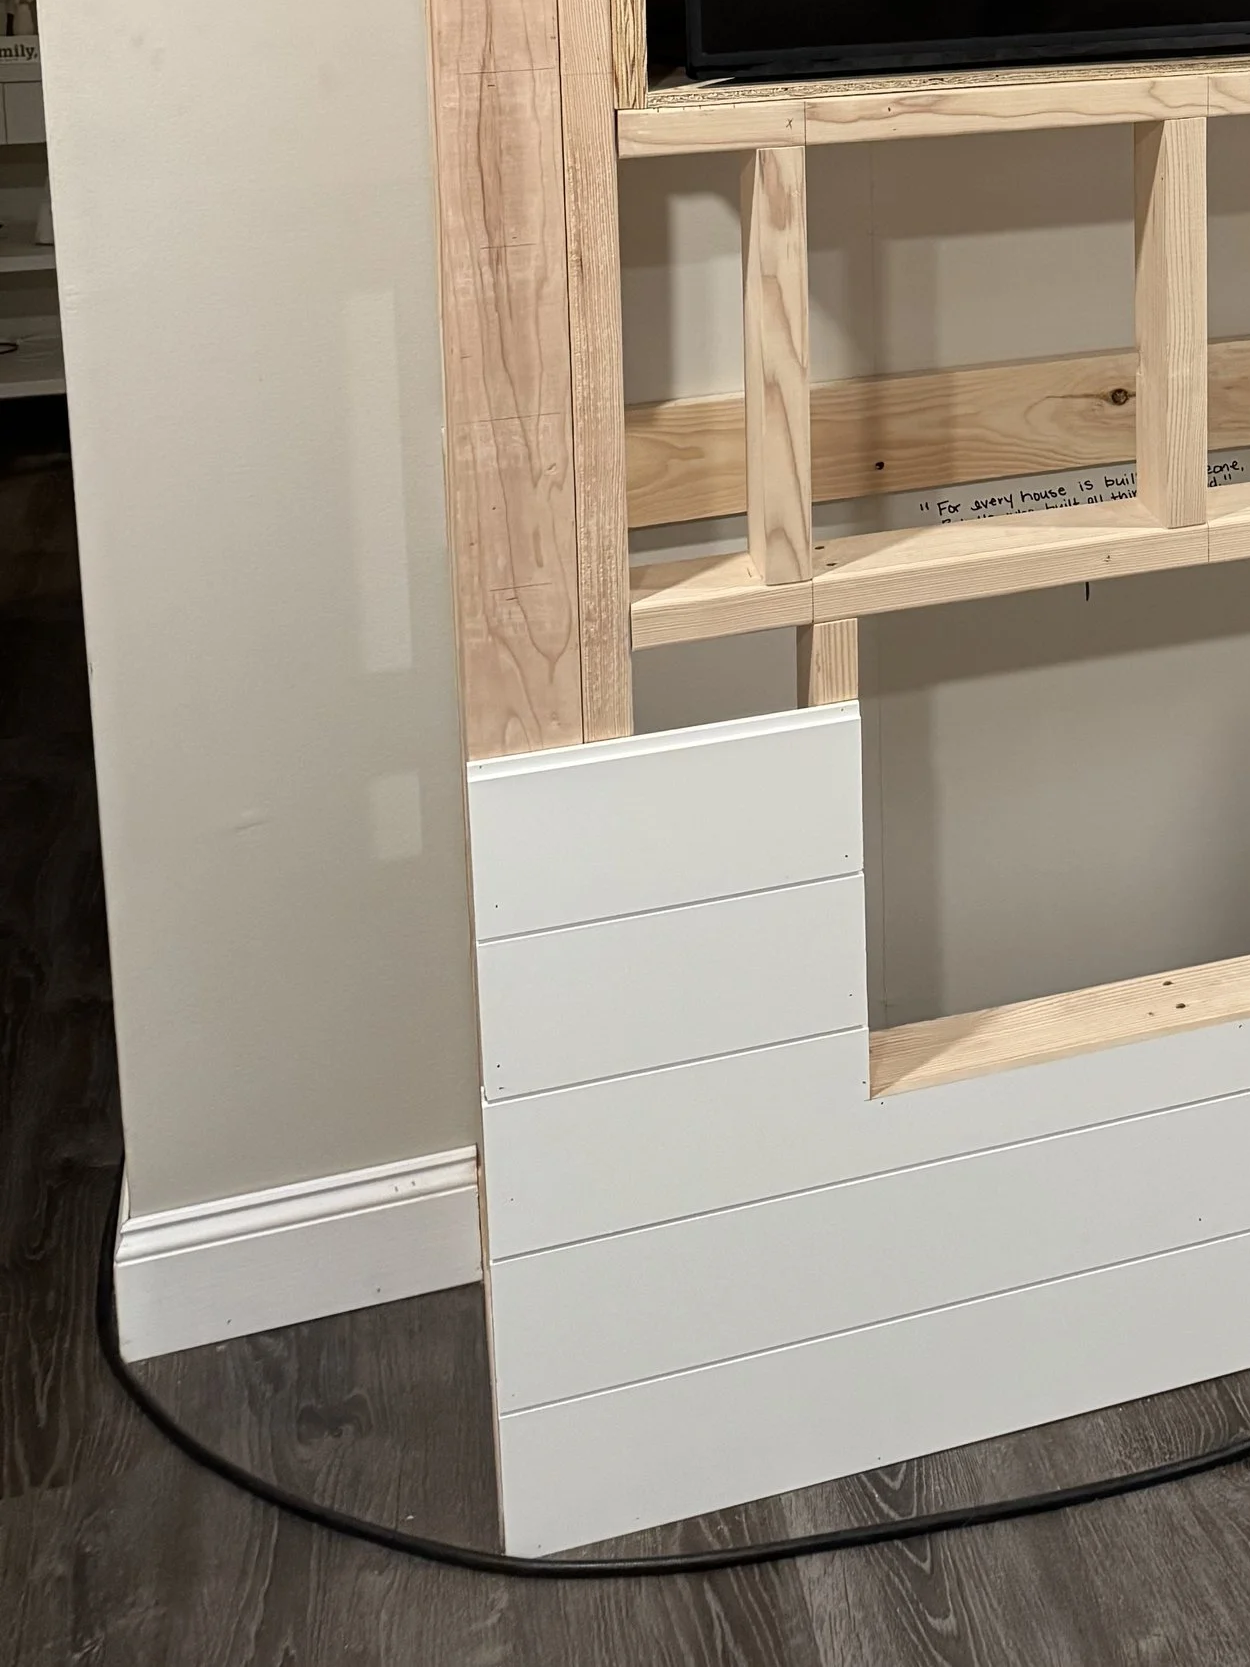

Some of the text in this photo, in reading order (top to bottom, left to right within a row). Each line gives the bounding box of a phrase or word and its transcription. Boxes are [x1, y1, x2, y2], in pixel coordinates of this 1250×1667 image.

[0, 43, 38, 61] mily,
[970, 493, 1014, 511] every
[1020, 486, 1067, 503] house
[1078, 478, 1095, 493] is
[1104, 472, 1137, 488] buil
